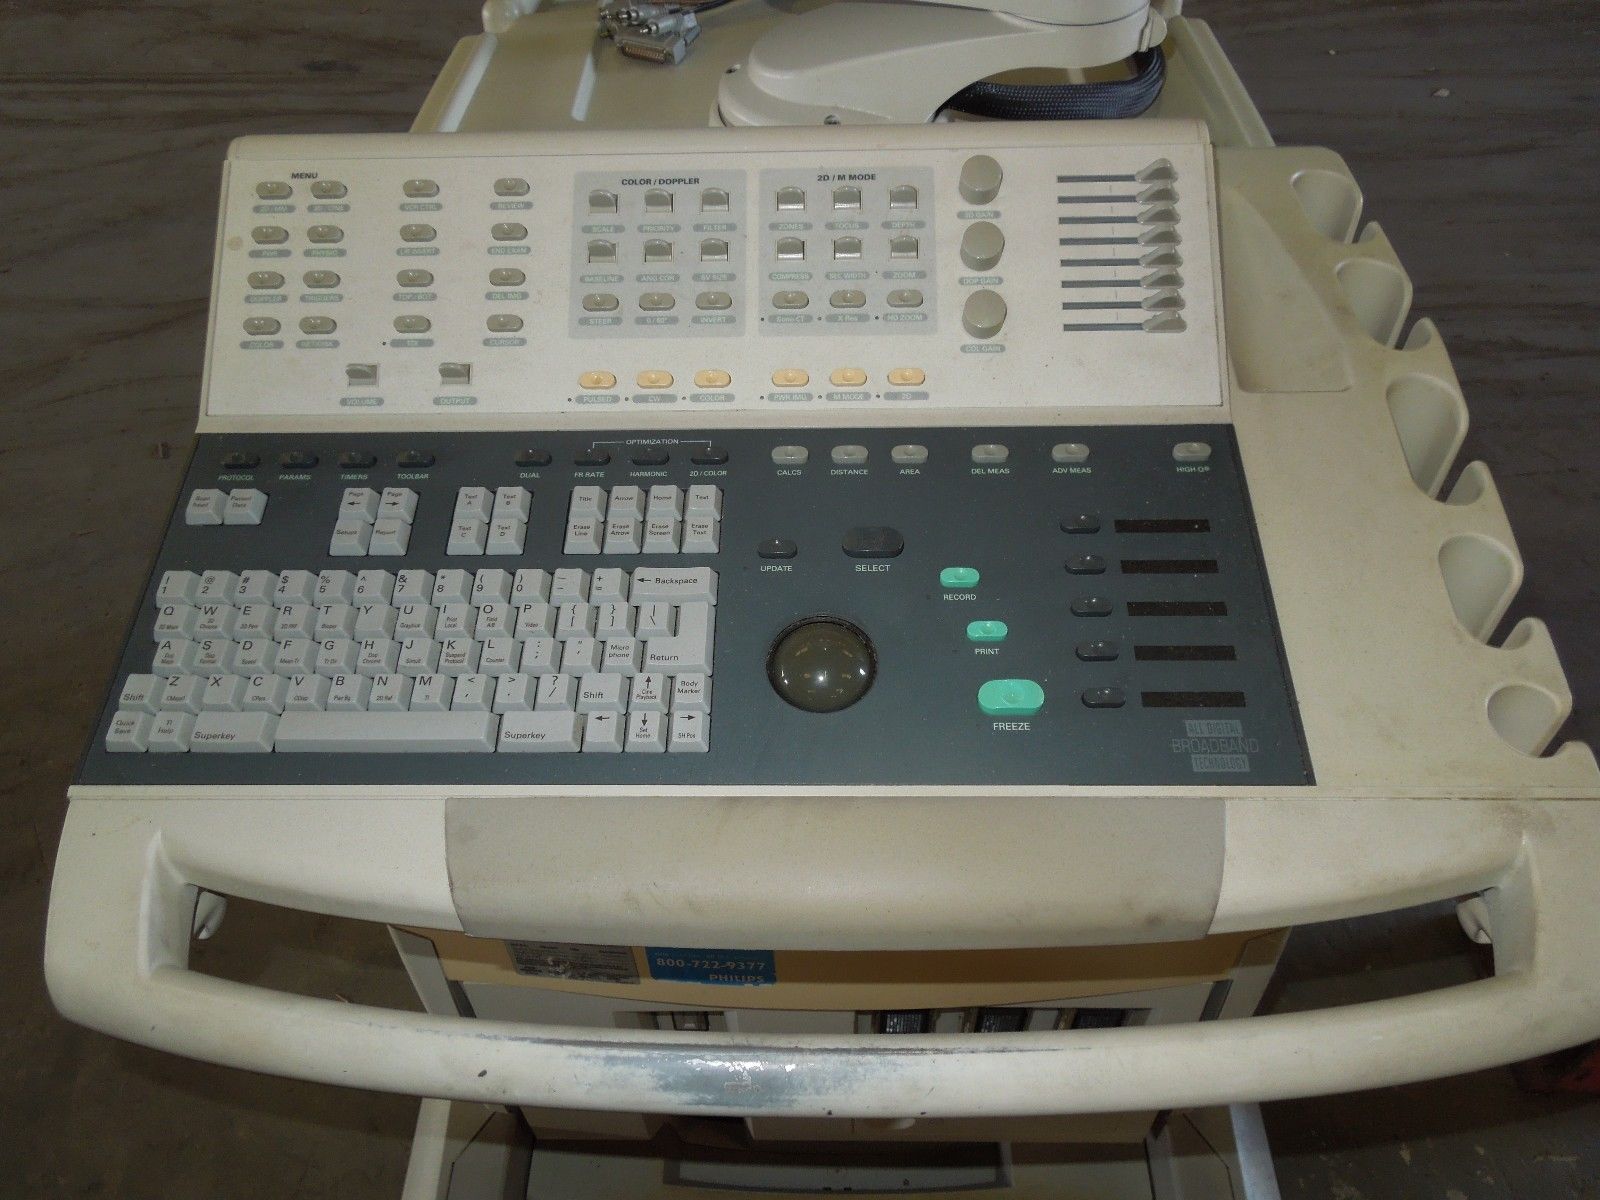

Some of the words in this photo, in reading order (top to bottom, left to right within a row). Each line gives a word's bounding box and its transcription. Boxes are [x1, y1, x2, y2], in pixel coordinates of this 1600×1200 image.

[621, 178, 652, 186] COLOR
[658, 177, 700, 185] DOPPLER
[836, 222, 860, 230] FOCUS
[893, 271, 916, 279] ZOOM
[855, 564, 890, 572] SELECT
[655, 577, 698, 585] Backspace
[162, 586, 167, 594] 1
[201, 586, 209, 594] 2
[239, 586, 247, 594] 3
[278, 586, 285, 594] 4
[320, 586, 326, 594] 5
[357, 585, 364, 594] 6
[398, 585, 405, 593] 7
[476, 584, 483, 592] 9
[516, 584, 523, 592] 0
[163, 606, 174, 616] Q
[204, 606, 218, 615] W
[243, 606, 252, 615] E
[283, 606, 292, 615] R
[324, 606, 332, 615] T
[364, 605, 373, 614] Y
[403, 605, 414, 614] U
[442, 605, 447, 614] I
[483, 604, 493, 614] O
[523, 604, 532, 614] P
[161, 641, 172, 650] A
[202, 640, 212, 650] S
[242, 641, 253, 650] D
[283, 640, 292, 650] F
[324, 640, 335, 650] G
[364, 640, 375, 650] H
[406, 640, 413, 649] J
[447, 640, 456, 649] K
[488, 639, 495, 649] L
[650, 653, 679, 661] Return
[169, 677, 179, 686] Z
[210, 677, 222, 687] X
[253, 677, 263, 686] C
[295, 677, 304, 686] V
[335, 676, 345, 686] B
[377, 676, 388, 686] N
[419, 676, 432, 686] M
[123, 693, 145, 701] Shift
[583, 691, 604, 699] Shift
[993, 722, 1031, 731] FREEZE
[1207, 721, 1240, 735] DIGITAL
[194, 731, 236, 741] Superkey
[504, 731, 546, 740] Superkey
[1172, 738, 1259, 753] BROADBAND
[1194, 755, 1248, 770] TECHNOLOGY
[656, 957, 766, 971] 800-722-9377
[709, 973, 764, 984] PHILIPS
